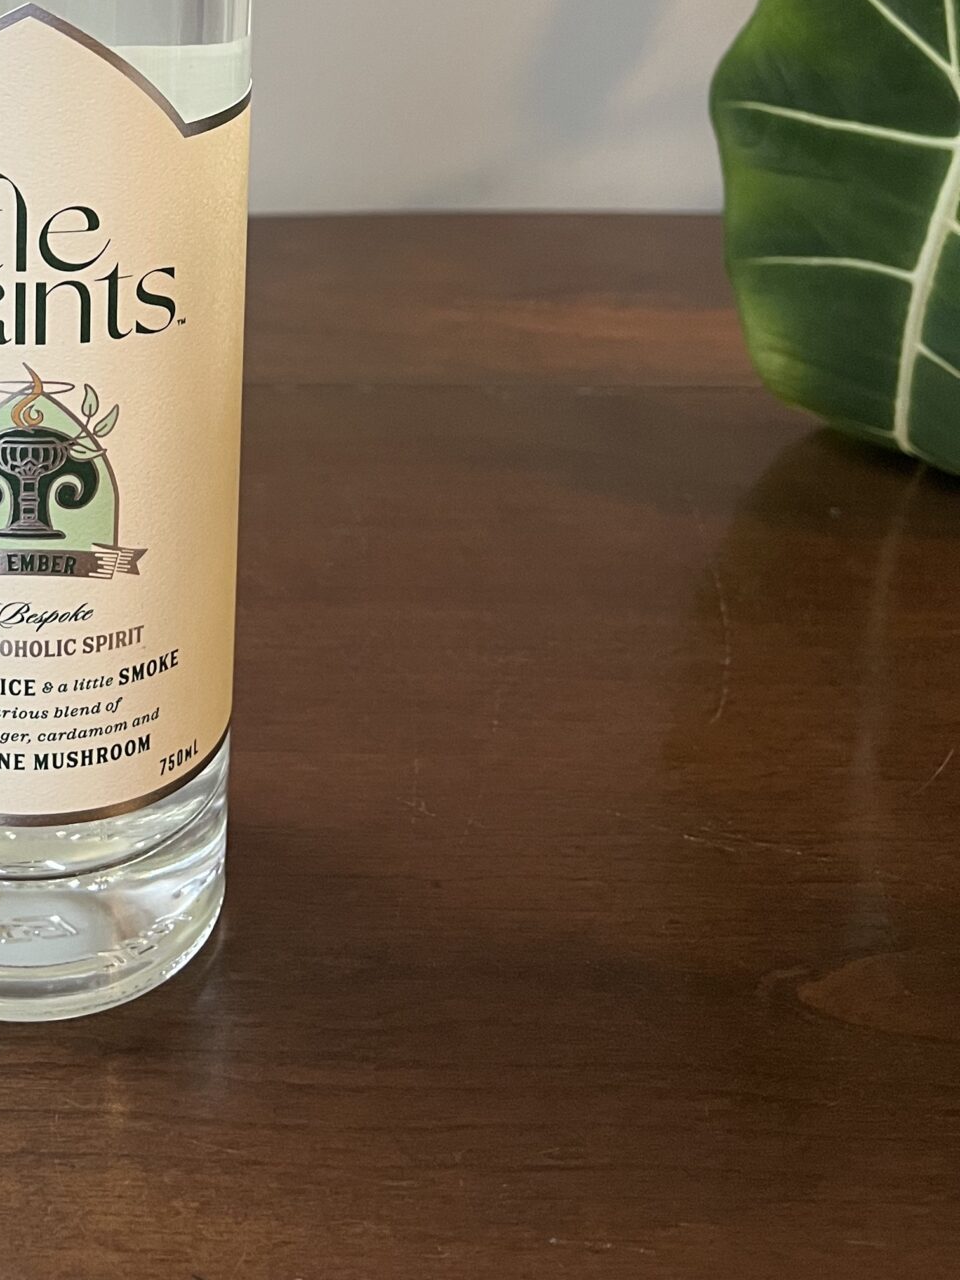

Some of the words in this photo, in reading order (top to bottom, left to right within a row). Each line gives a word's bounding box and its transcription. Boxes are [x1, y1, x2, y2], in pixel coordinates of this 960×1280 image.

[6, 554, 77, 574] EMBER
[82, 625, 144, 654] SPIRIT
[42, 681, 54, 694] &
[58, 682, 68, 693] a
[73, 675, 114, 692] little
[118, 648, 179, 686] SMOKE
[53, 701, 101, 719] blend
[105, 696, 123, 713] of
[37, 720, 128, 742] cardamom
[132, 707, 160, 728] and
[33, 733, 151, 771] MUSHROOM
